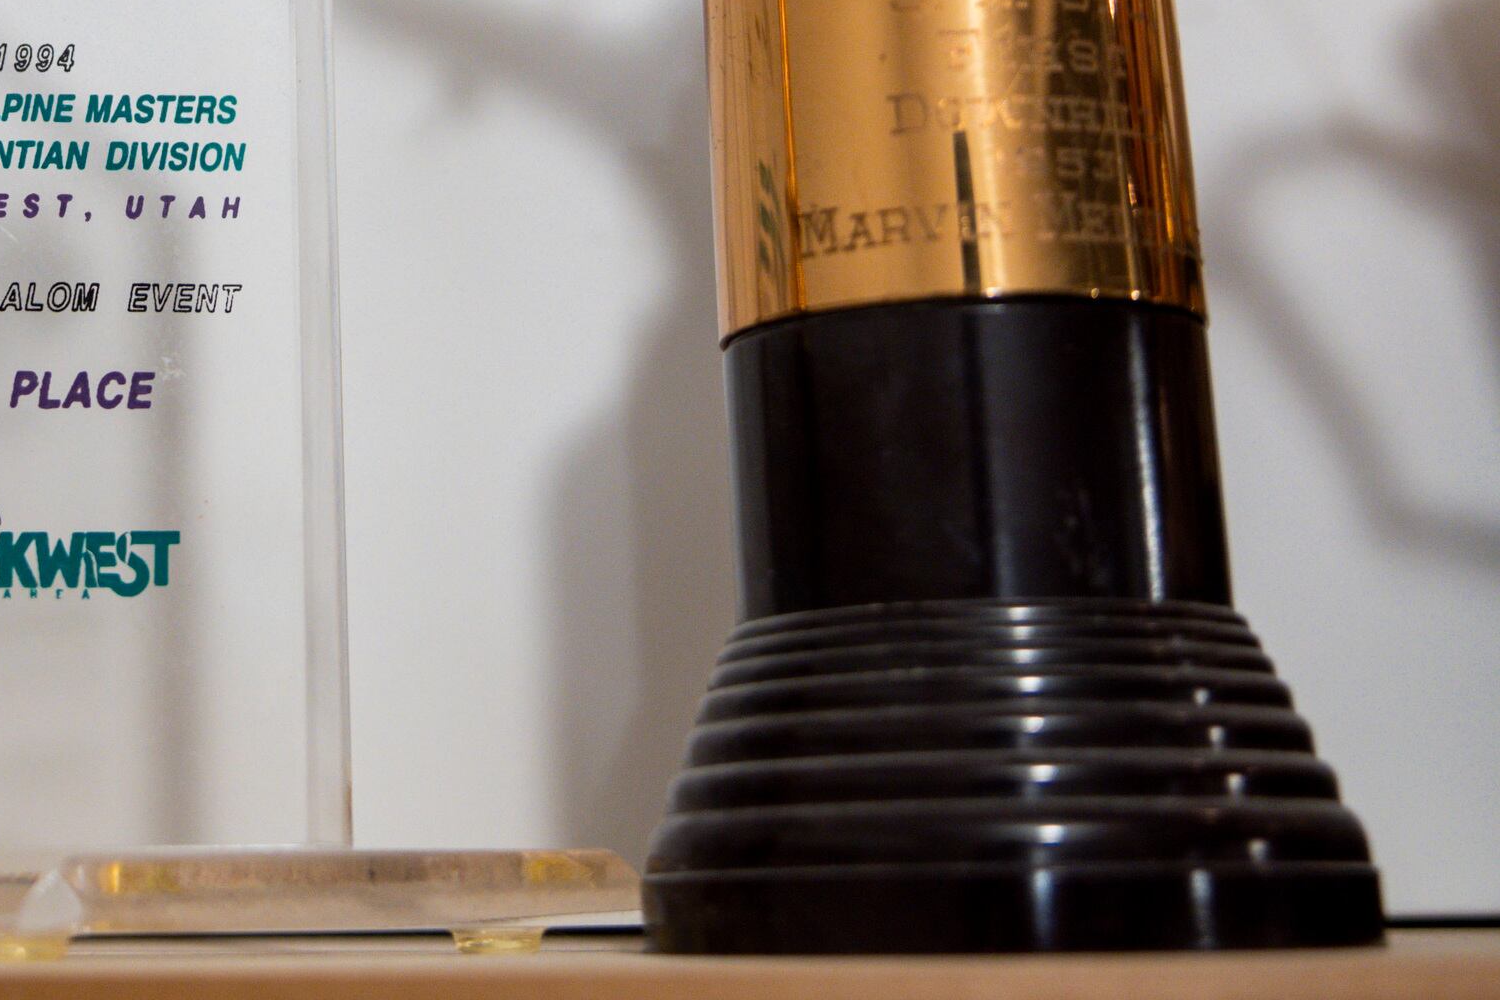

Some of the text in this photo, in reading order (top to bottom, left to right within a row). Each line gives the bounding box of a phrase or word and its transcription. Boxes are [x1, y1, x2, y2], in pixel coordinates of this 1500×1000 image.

[85, 94, 238, 125] MASTERS
[105, 141, 247, 172] DIVISION
[125, 195, 240, 220] UTAH
[127, 283, 243, 313] EVENT
[10, 371, 155, 410] PLACE
